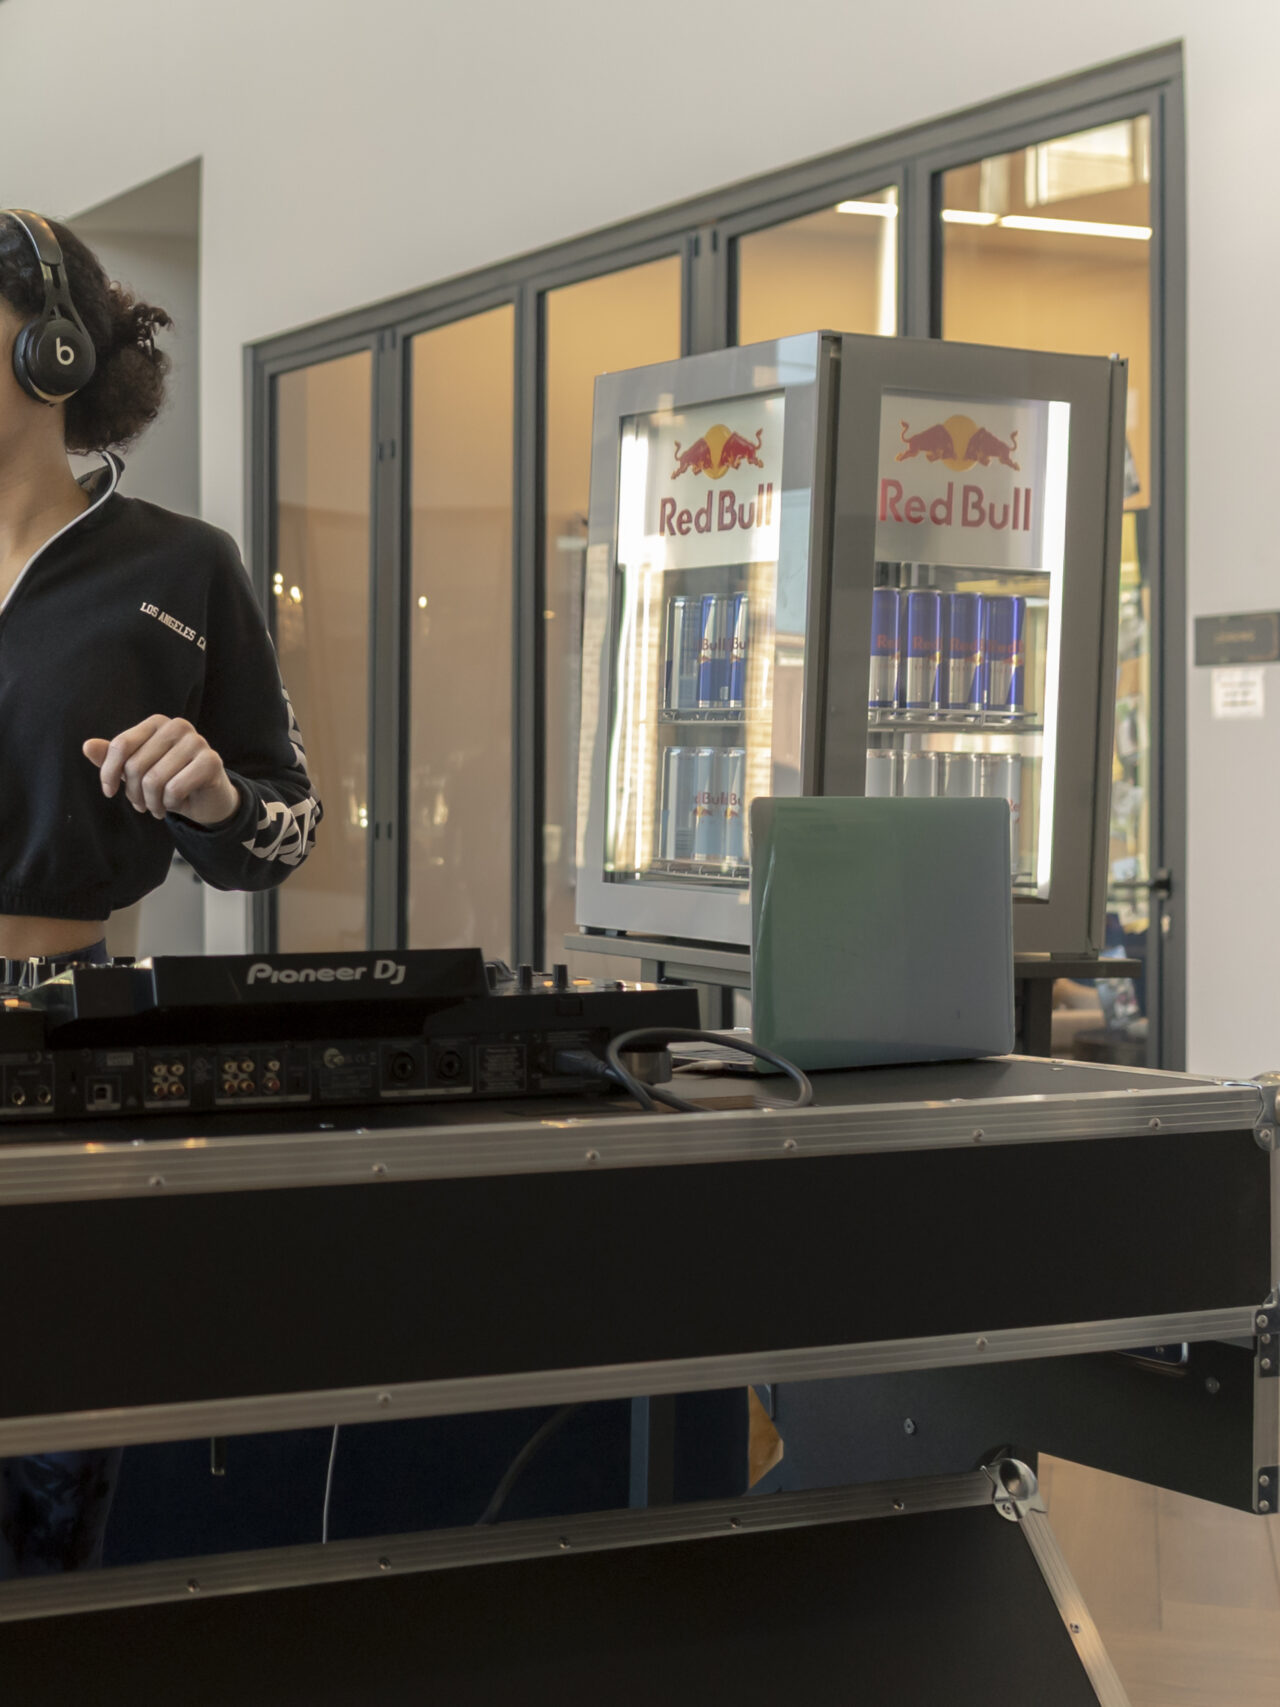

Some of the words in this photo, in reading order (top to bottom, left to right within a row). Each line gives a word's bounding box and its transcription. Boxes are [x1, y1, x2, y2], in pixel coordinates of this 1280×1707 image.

[659, 489, 713, 536] Red
[717, 482, 773, 531] Bull
[878, 477, 954, 525] Red
[960, 484, 1032, 532] Bull
[139, 601, 160, 618] LOS
[158, 611, 197, 641] ANGELES
[246, 962, 368, 986] Pioneer
[373, 958, 408, 986] DJ
